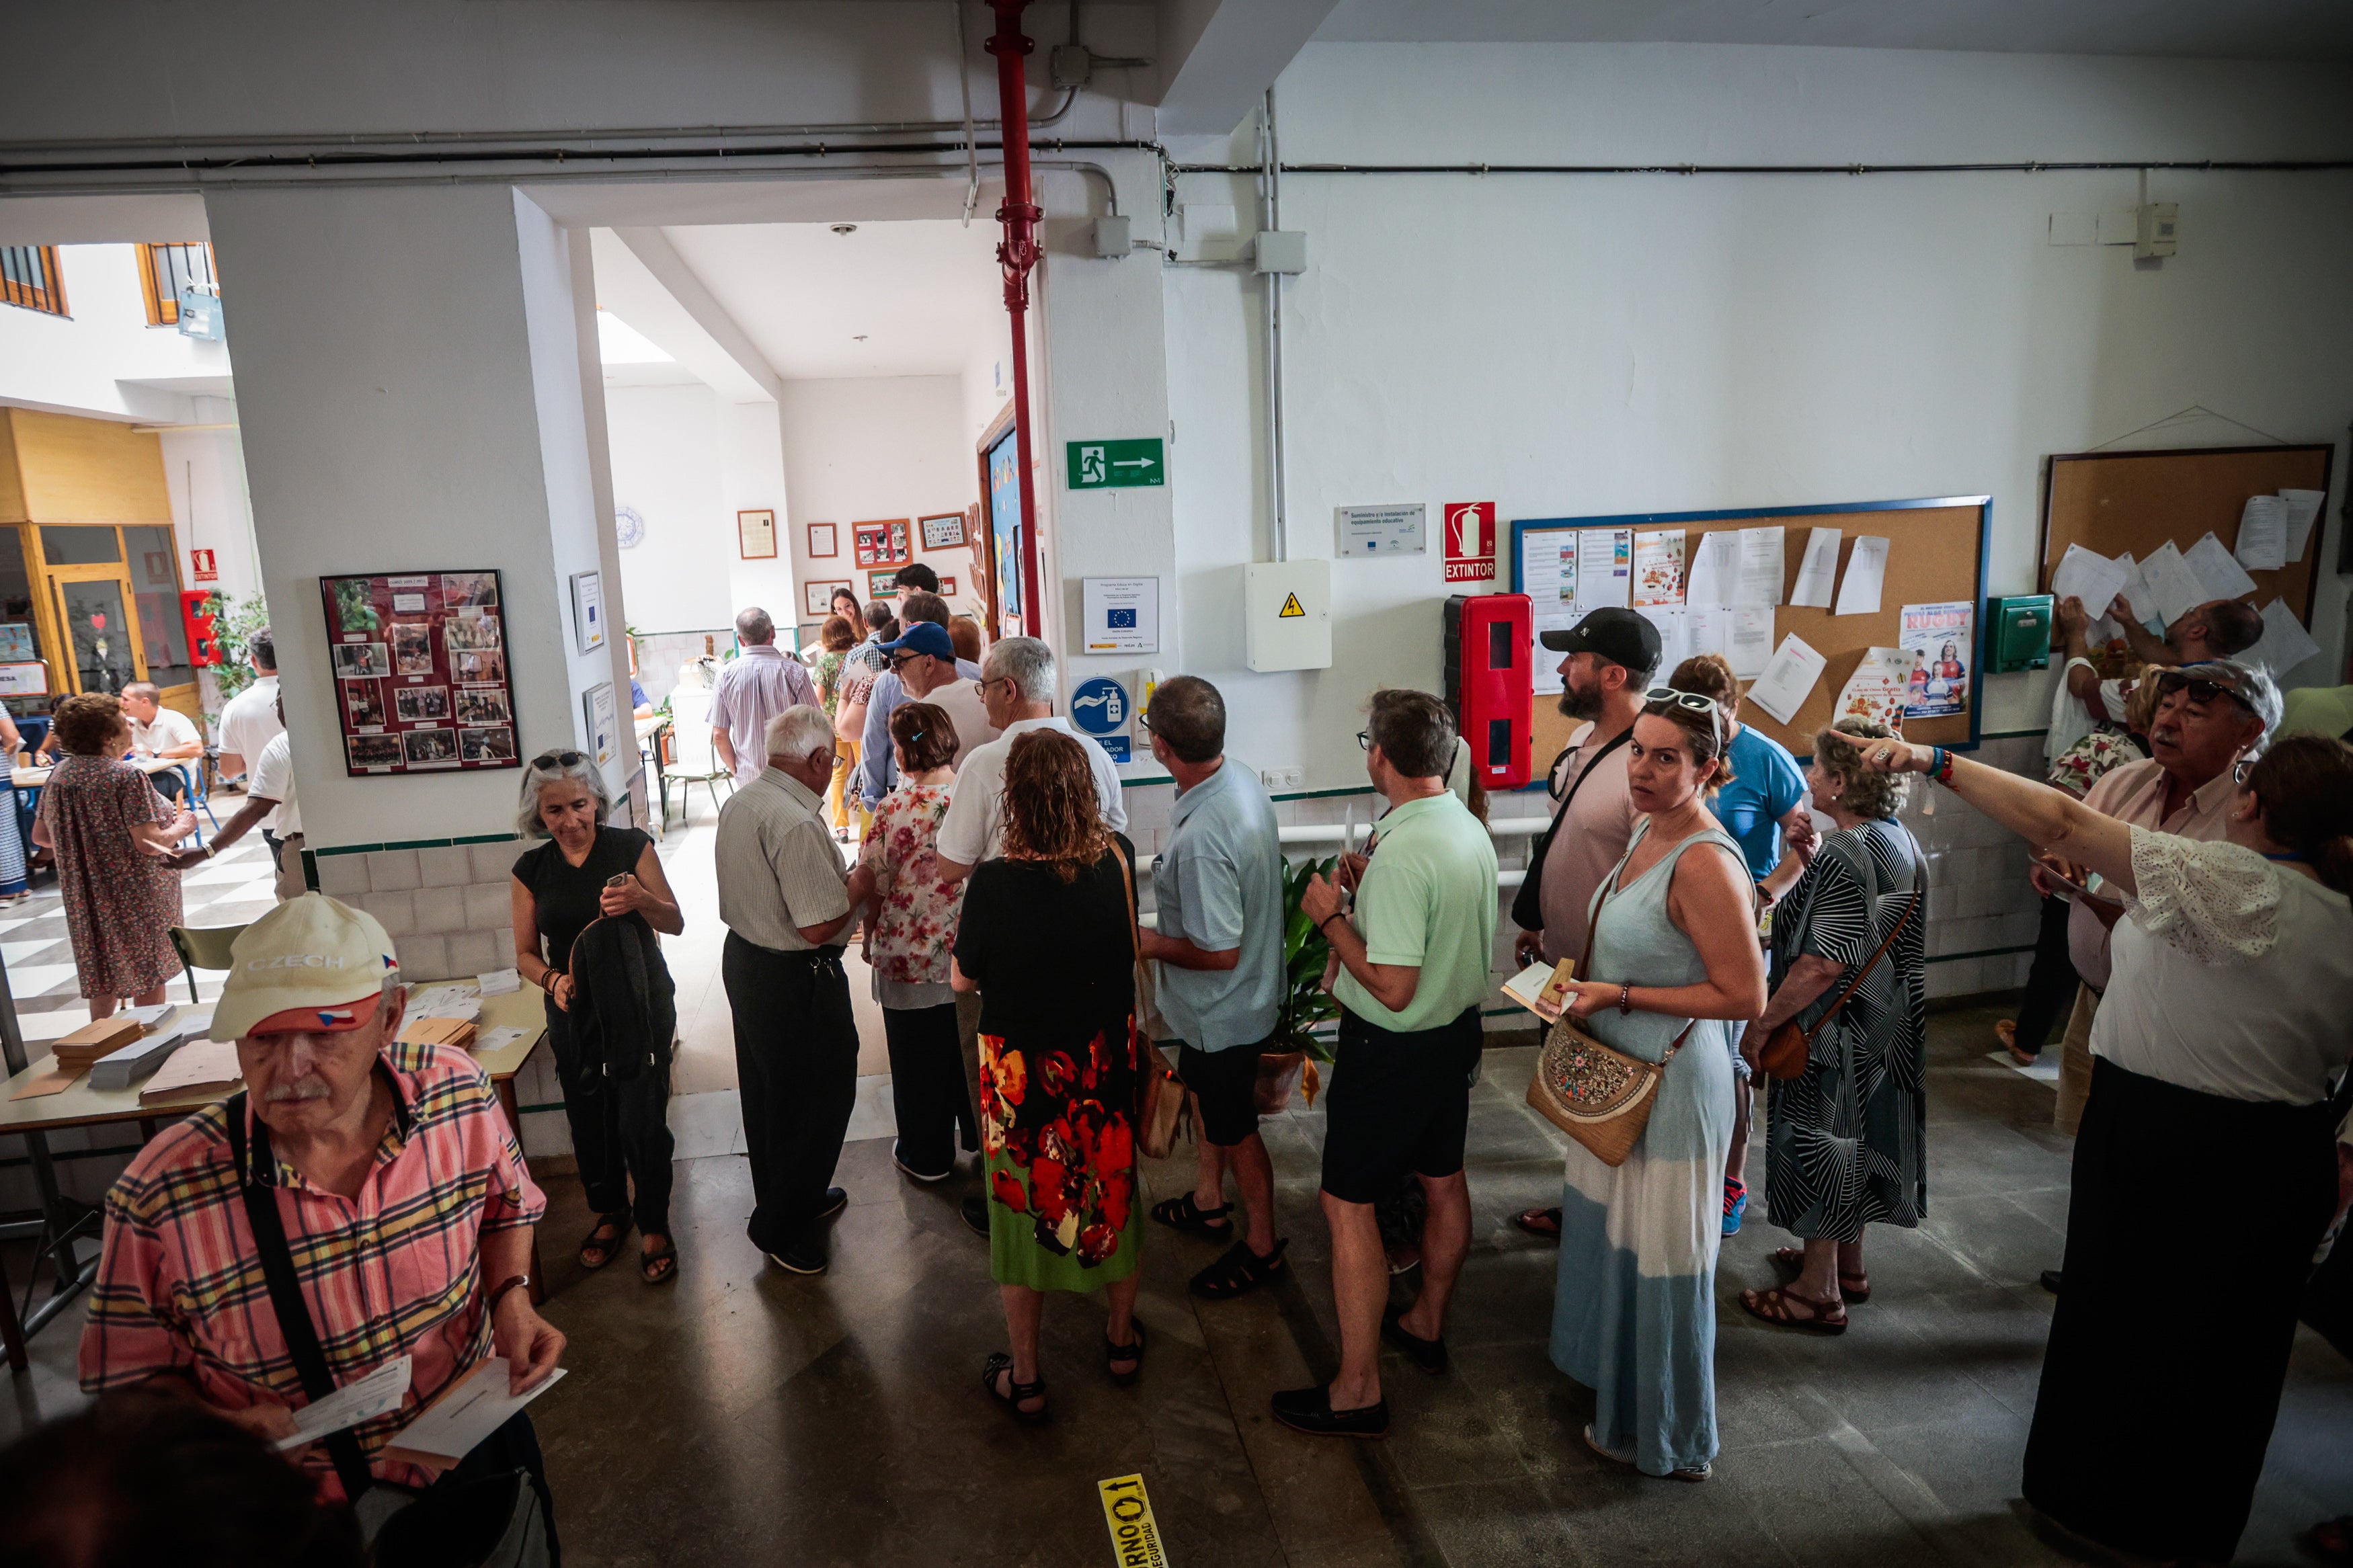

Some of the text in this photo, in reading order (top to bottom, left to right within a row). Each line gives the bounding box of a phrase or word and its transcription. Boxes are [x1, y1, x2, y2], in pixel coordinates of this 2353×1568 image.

[195, 572, 217, 581] EXTINTOR
[1446, 563, 1494, 579] EXTINTOR
[1907, 612, 1969, 630] RUGBY
[248, 954, 344, 972] CZECH
[1117, 1524, 1149, 1568] RNO
